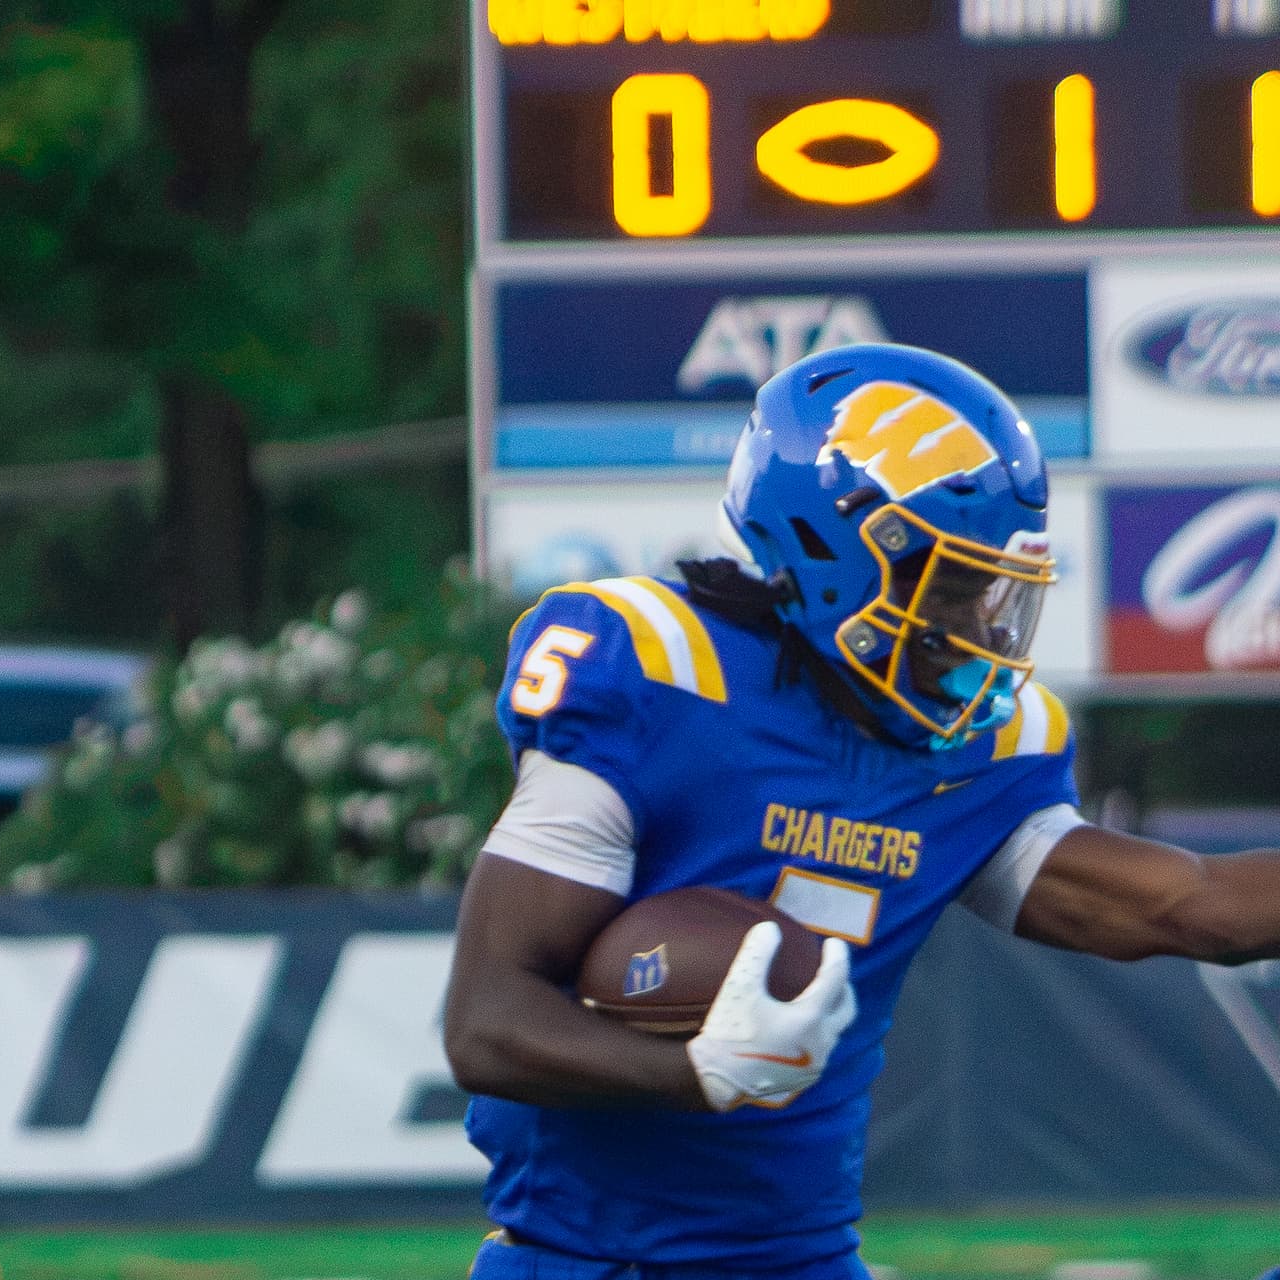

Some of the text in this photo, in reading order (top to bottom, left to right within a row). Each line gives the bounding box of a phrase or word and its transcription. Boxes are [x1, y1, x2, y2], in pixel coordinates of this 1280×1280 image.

[612, 73, 711, 236] 0
[1054, 73, 1097, 222] 1
[511, 624, 596, 717] 5
[761, 803, 922, 880] CHARGERS
